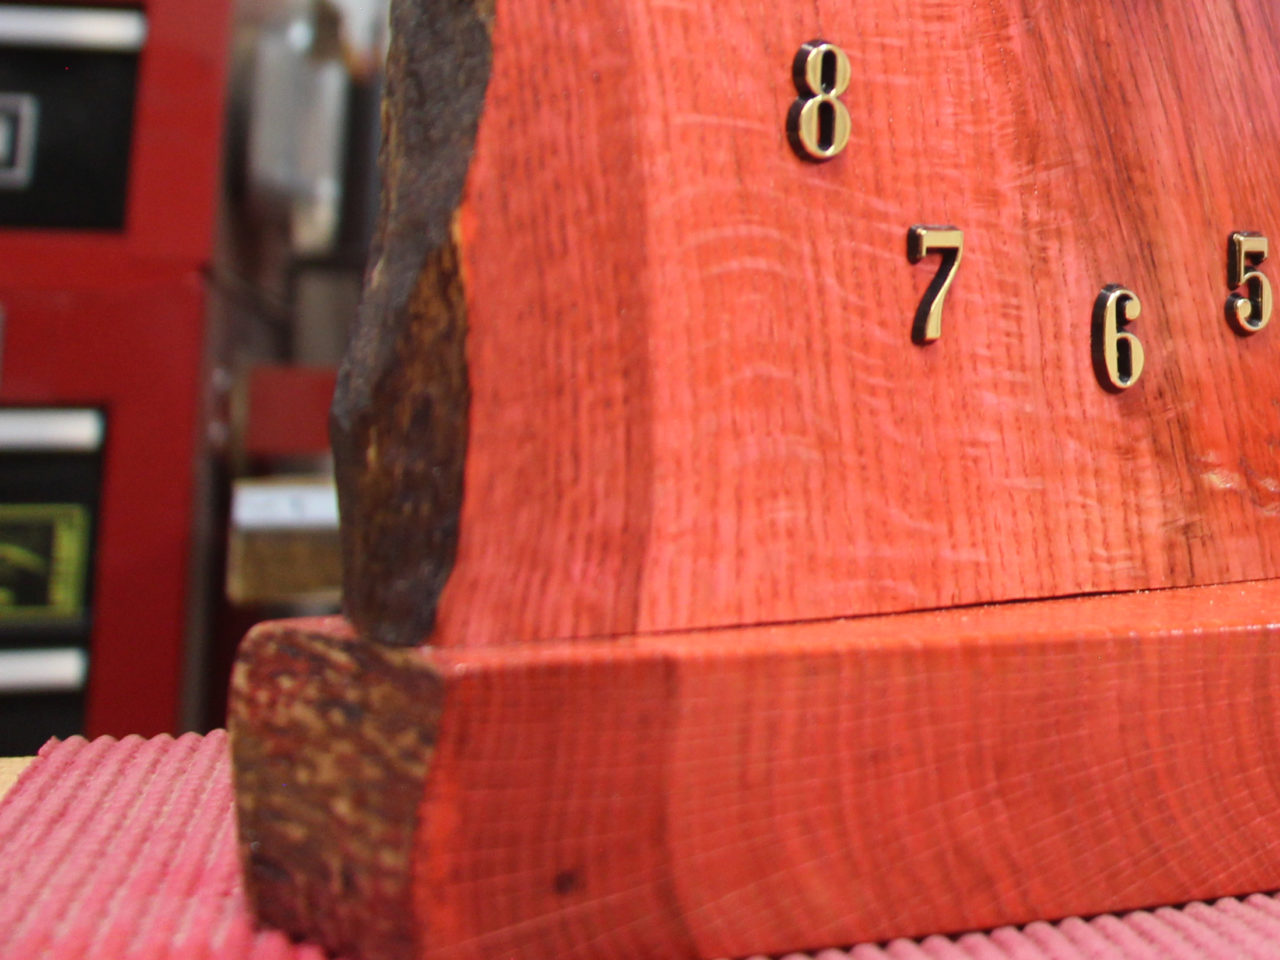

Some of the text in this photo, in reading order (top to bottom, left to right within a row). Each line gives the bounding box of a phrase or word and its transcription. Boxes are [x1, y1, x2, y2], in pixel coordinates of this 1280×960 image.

[788, 40, 851, 160] 8
[908, 225, 962, 343] 7
[1092, 284, 1143, 389] 6
[1226, 231, 1272, 333] 5
